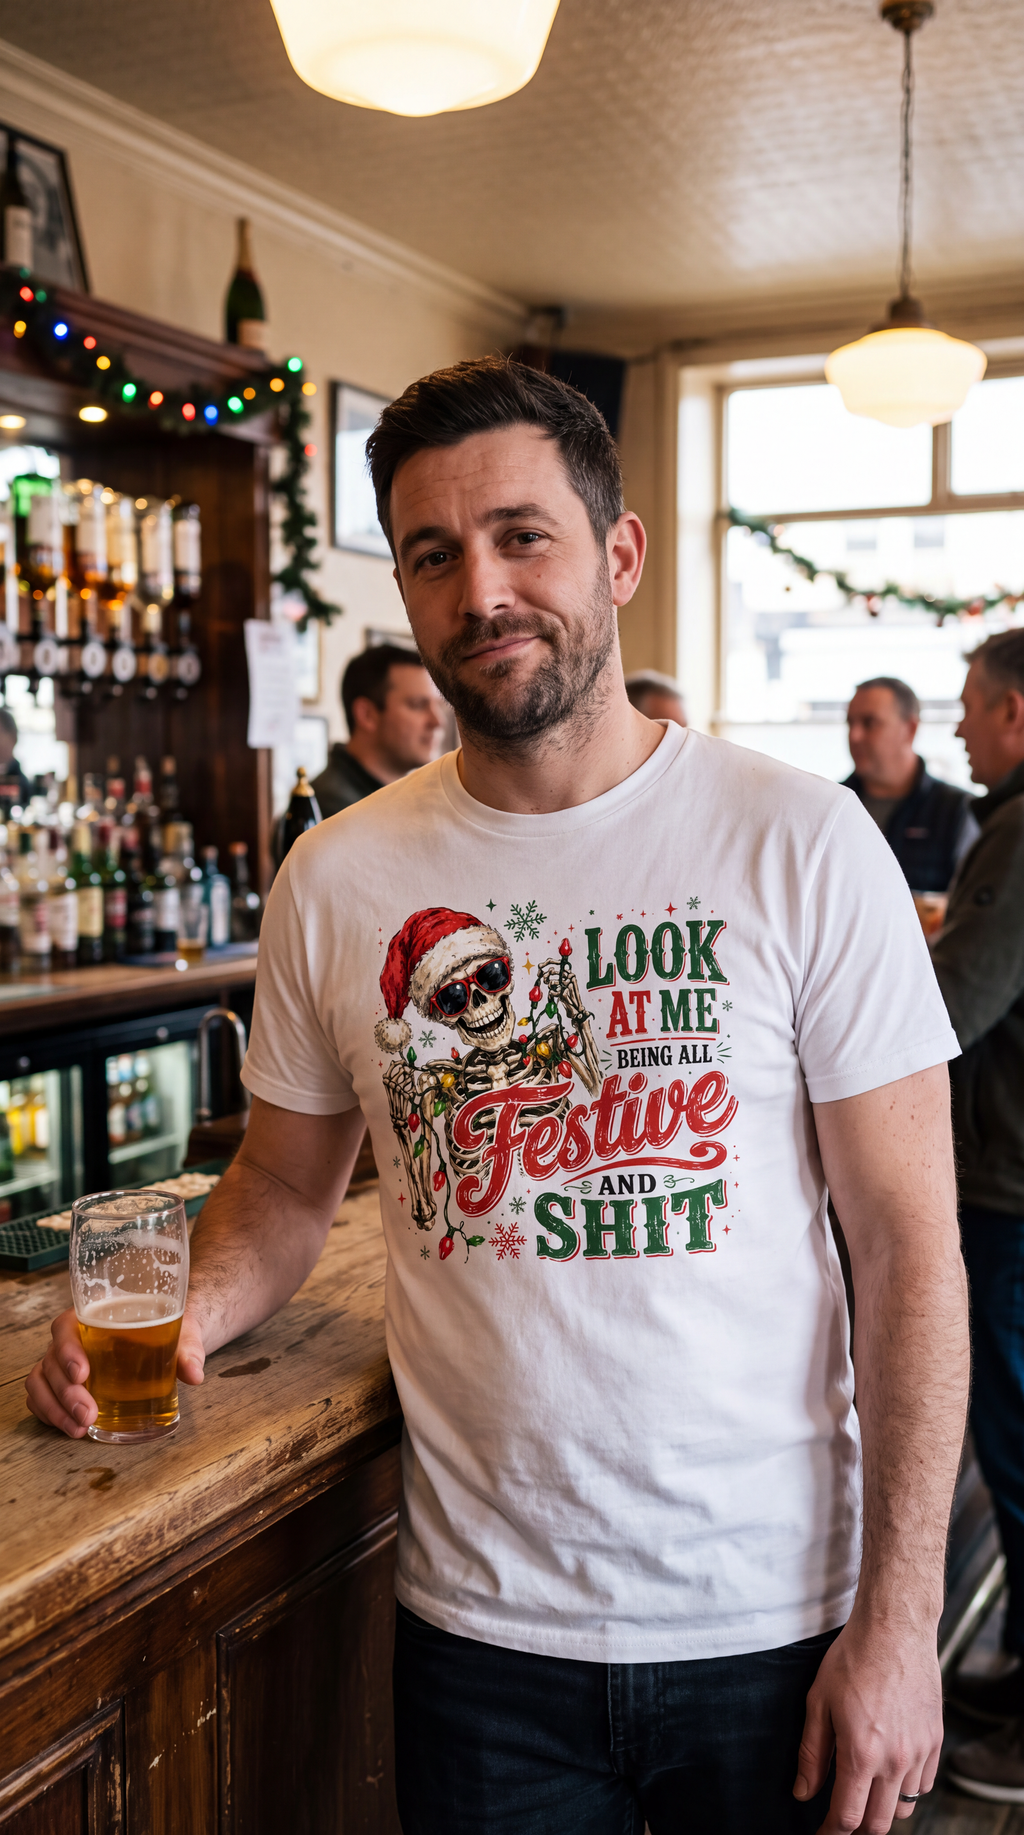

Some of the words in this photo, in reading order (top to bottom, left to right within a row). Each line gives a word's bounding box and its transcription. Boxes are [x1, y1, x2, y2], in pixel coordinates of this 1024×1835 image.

[584, 920, 729, 991] LOOK
[606, 990, 651, 1039] AT
[659, 988, 720, 1034] ME
[617, 1045, 673, 1070] BEING
[678, 1044, 713, 1065] ALL
[453, 1070, 739, 1218] Festive
[598, 1173, 657, 1196] AND
[534, 1178, 728, 1262] SHIT
